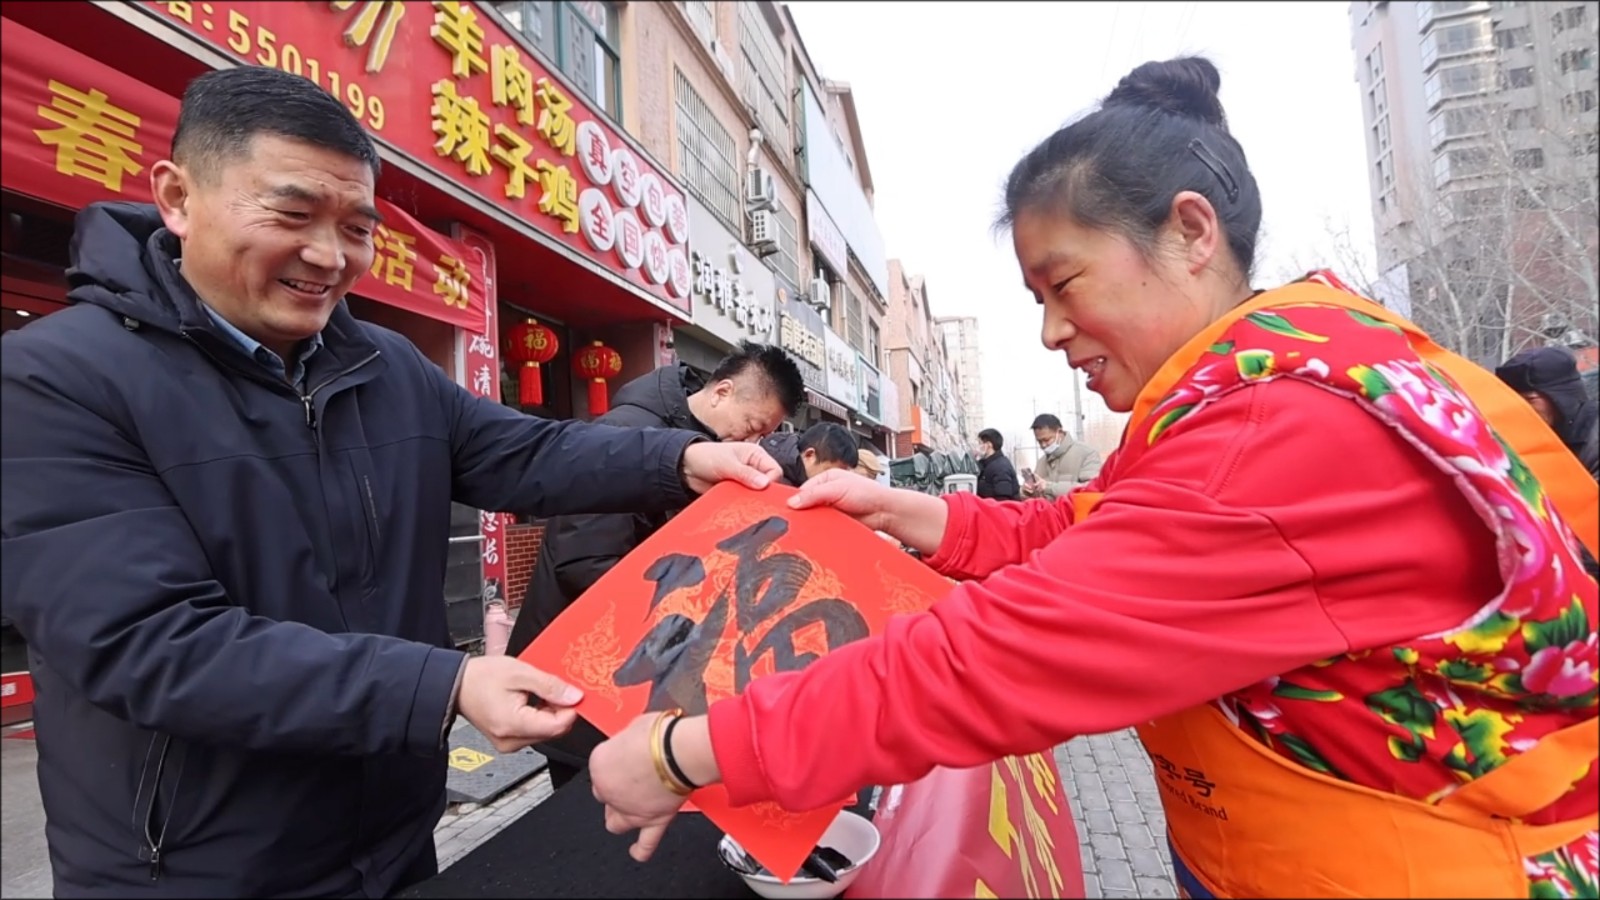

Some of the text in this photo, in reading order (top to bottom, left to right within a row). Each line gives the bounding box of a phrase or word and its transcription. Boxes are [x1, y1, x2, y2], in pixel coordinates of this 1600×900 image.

[430, 1, 576, 157] 羊肉汤
[431, 78, 579, 234] 辣子鸡
[33, 79, 143, 192] 春
[370, 222, 470, 310] 活动
[524, 329, 547, 350] 福
